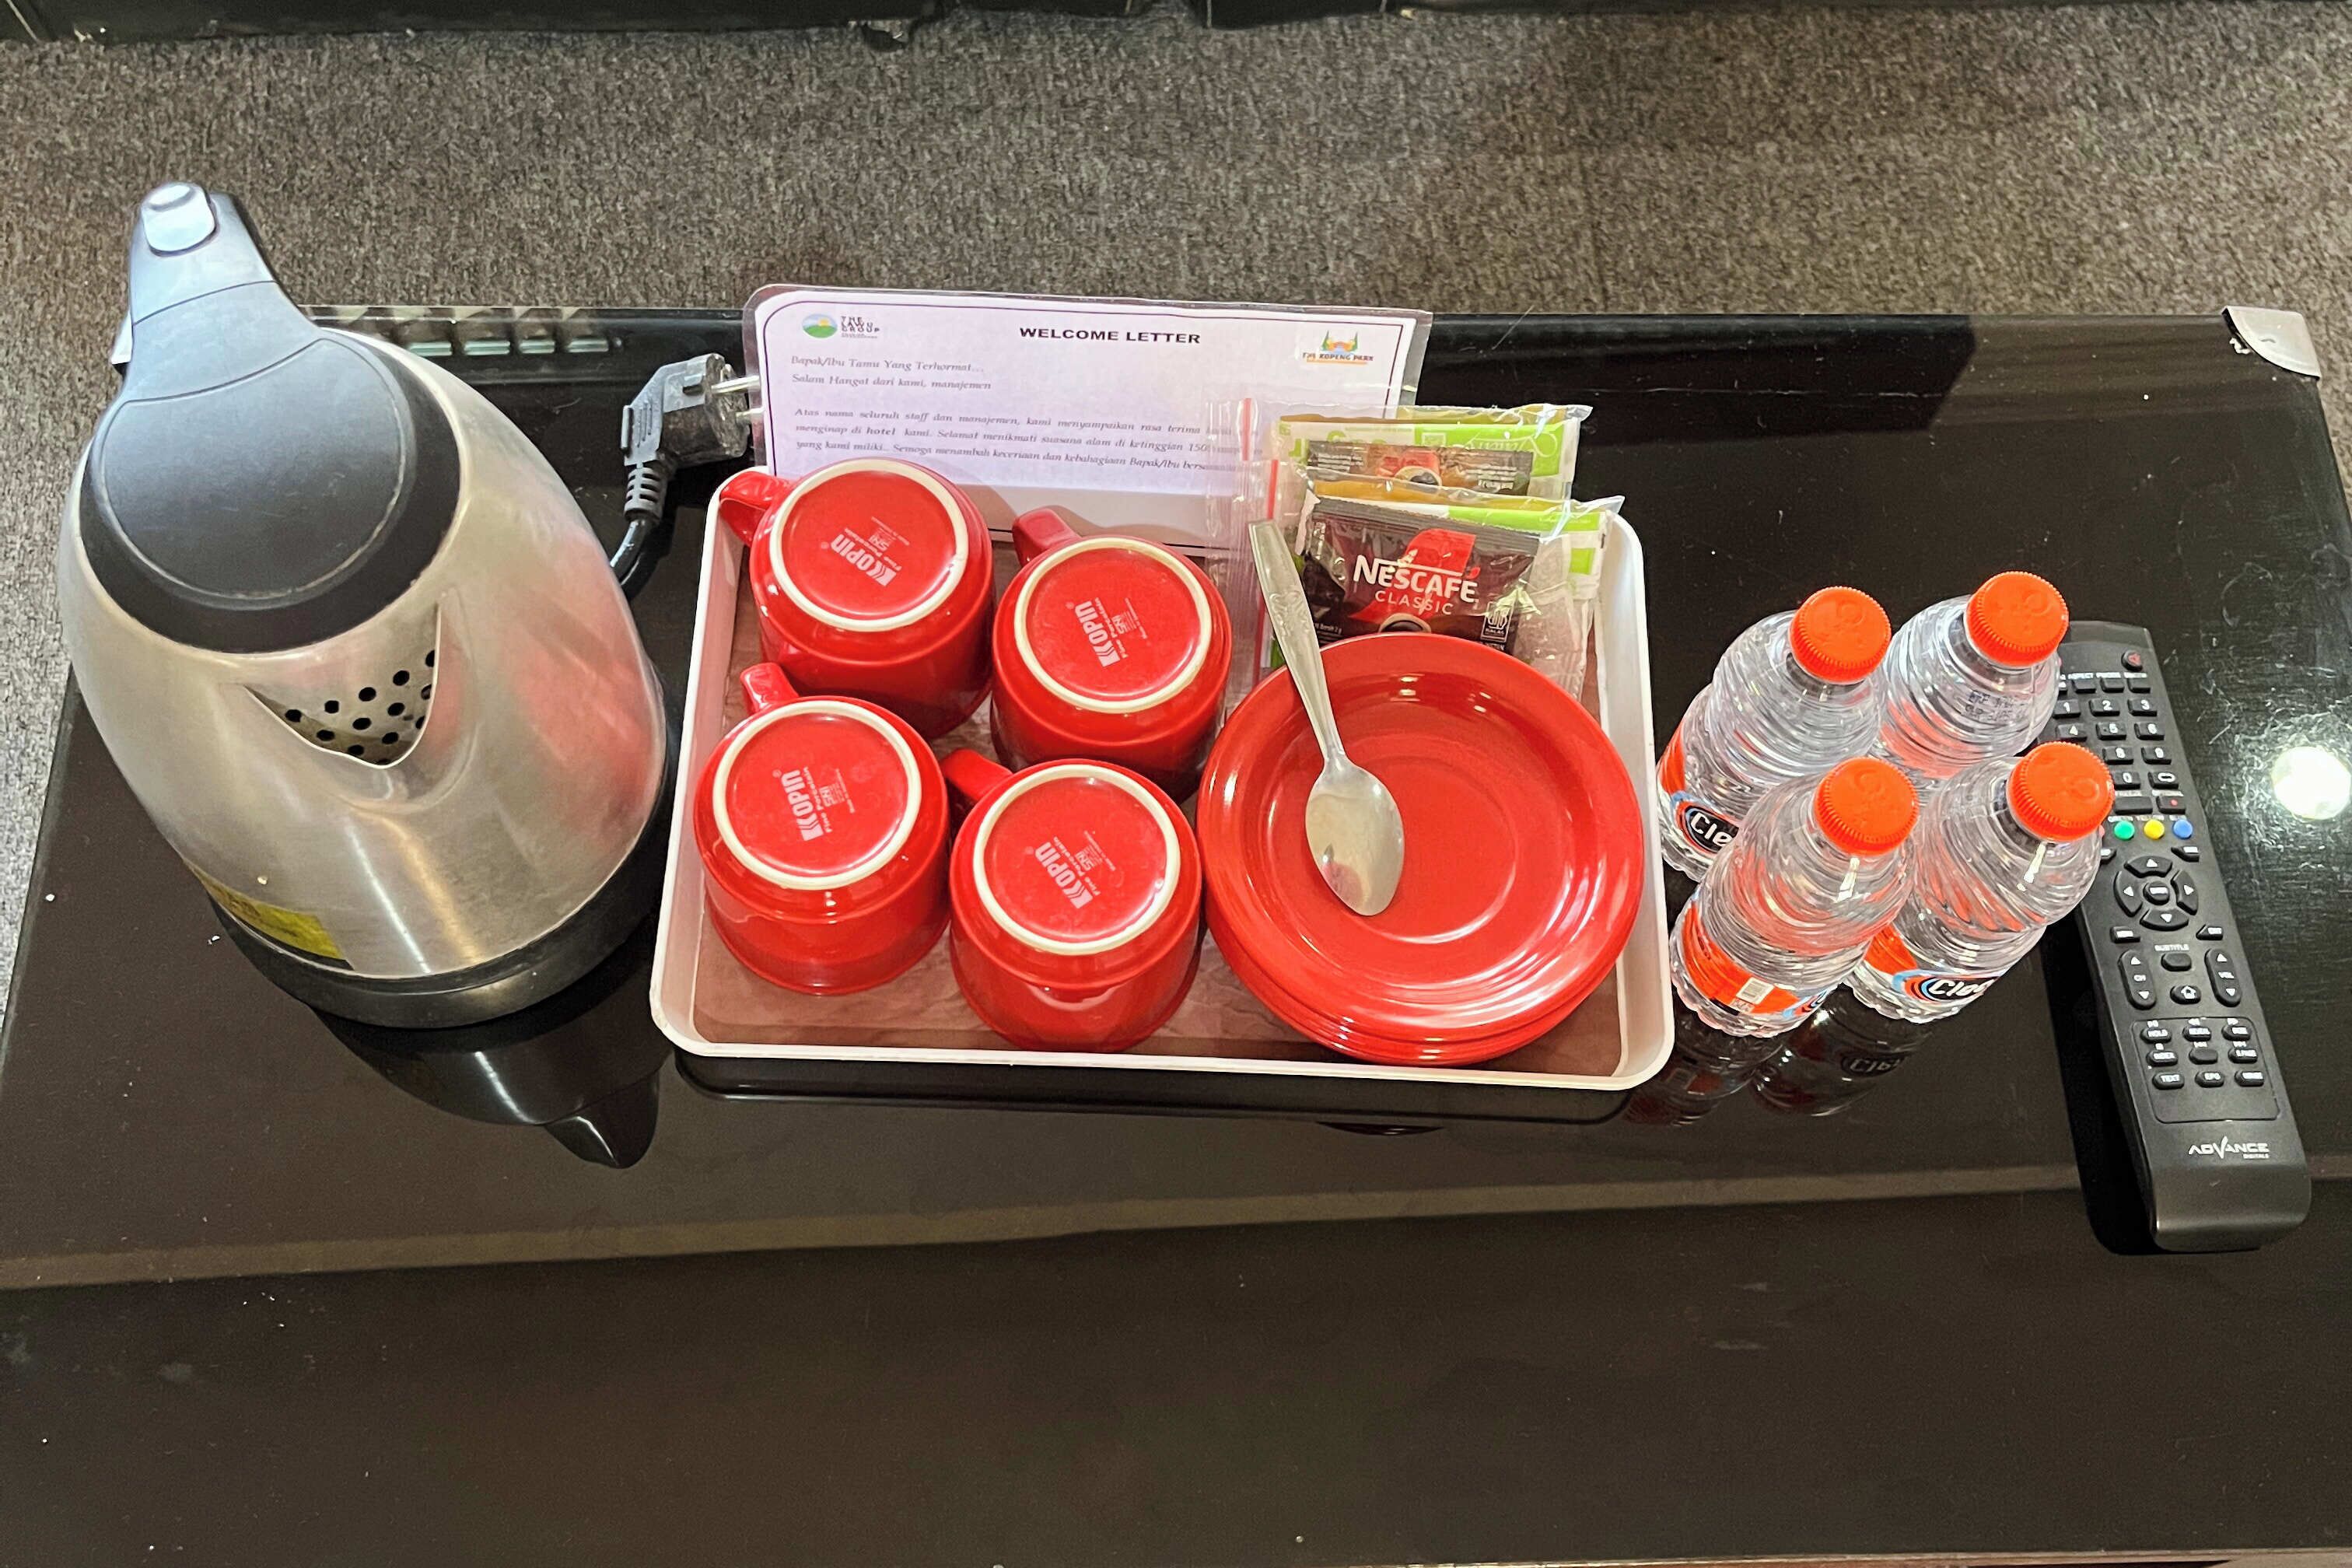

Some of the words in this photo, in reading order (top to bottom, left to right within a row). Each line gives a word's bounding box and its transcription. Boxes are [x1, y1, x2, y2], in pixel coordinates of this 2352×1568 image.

[1020, 327, 1118, 341] WELCOME
[1125, 331, 1201, 344] LETTER
[791, 355, 845, 369] Bapak/Ibu
[849, 359, 880, 368] Tamu
[884, 360, 912, 372] Yang
[792, 373, 824, 384] Salam
[829, 376, 869, 387] Hangat
[873, 377, 894, 387] dari
[931, 380, 992, 390] manajemen
[859, 411, 900, 420] seluruh
[905, 412, 929, 422] staff
[933, 413, 953, 422] dan
[1026, 417, 1052, 426] kami
[1058, 421, 1135, 432] menyampaikan
[1167, 424, 1201, 434] terima
[796, 425, 848, 436] menginap
[851, 425, 862, 435] di
[866, 427, 895, 436] hotel
[936, 429, 979, 439] Selamat
[982, 432, 1037, 443] menikmati
[1087, 437, 1111, 446] alam
[1115, 439, 1125, 447] di
[1129, 439, 1183, 451] ketinggian
[796, 441, 823, 450] yang
[825, 441, 850, 450] kami
[894, 444, 932, 455] Semoga
[935, 446, 990, 457] menambah
[1043, 452, 1062, 461] dan
[1065, 453, 1126, 466] kebahagiaan
[1129, 457, 1180, 468] Bapak/Ibu
[830, 534, 897, 587] KOPIN
[1374, 590, 1454, 615] CLASSIC
[1074, 600, 1121, 667] KOPIN
[2063, 702, 2070, 712] 1
[2102, 700, 2112, 711] 2
[2140, 699, 2150, 710] 3
[2069, 724, 2078, 736] 4
[2109, 723, 2119, 733] 5
[2123, 772, 2132, 783] 0
[781, 769, 824, 842] KOPIN
[1034, 842, 1094, 909] KOPIN
[2188, 1136, 2270, 1160] ADVANCE
